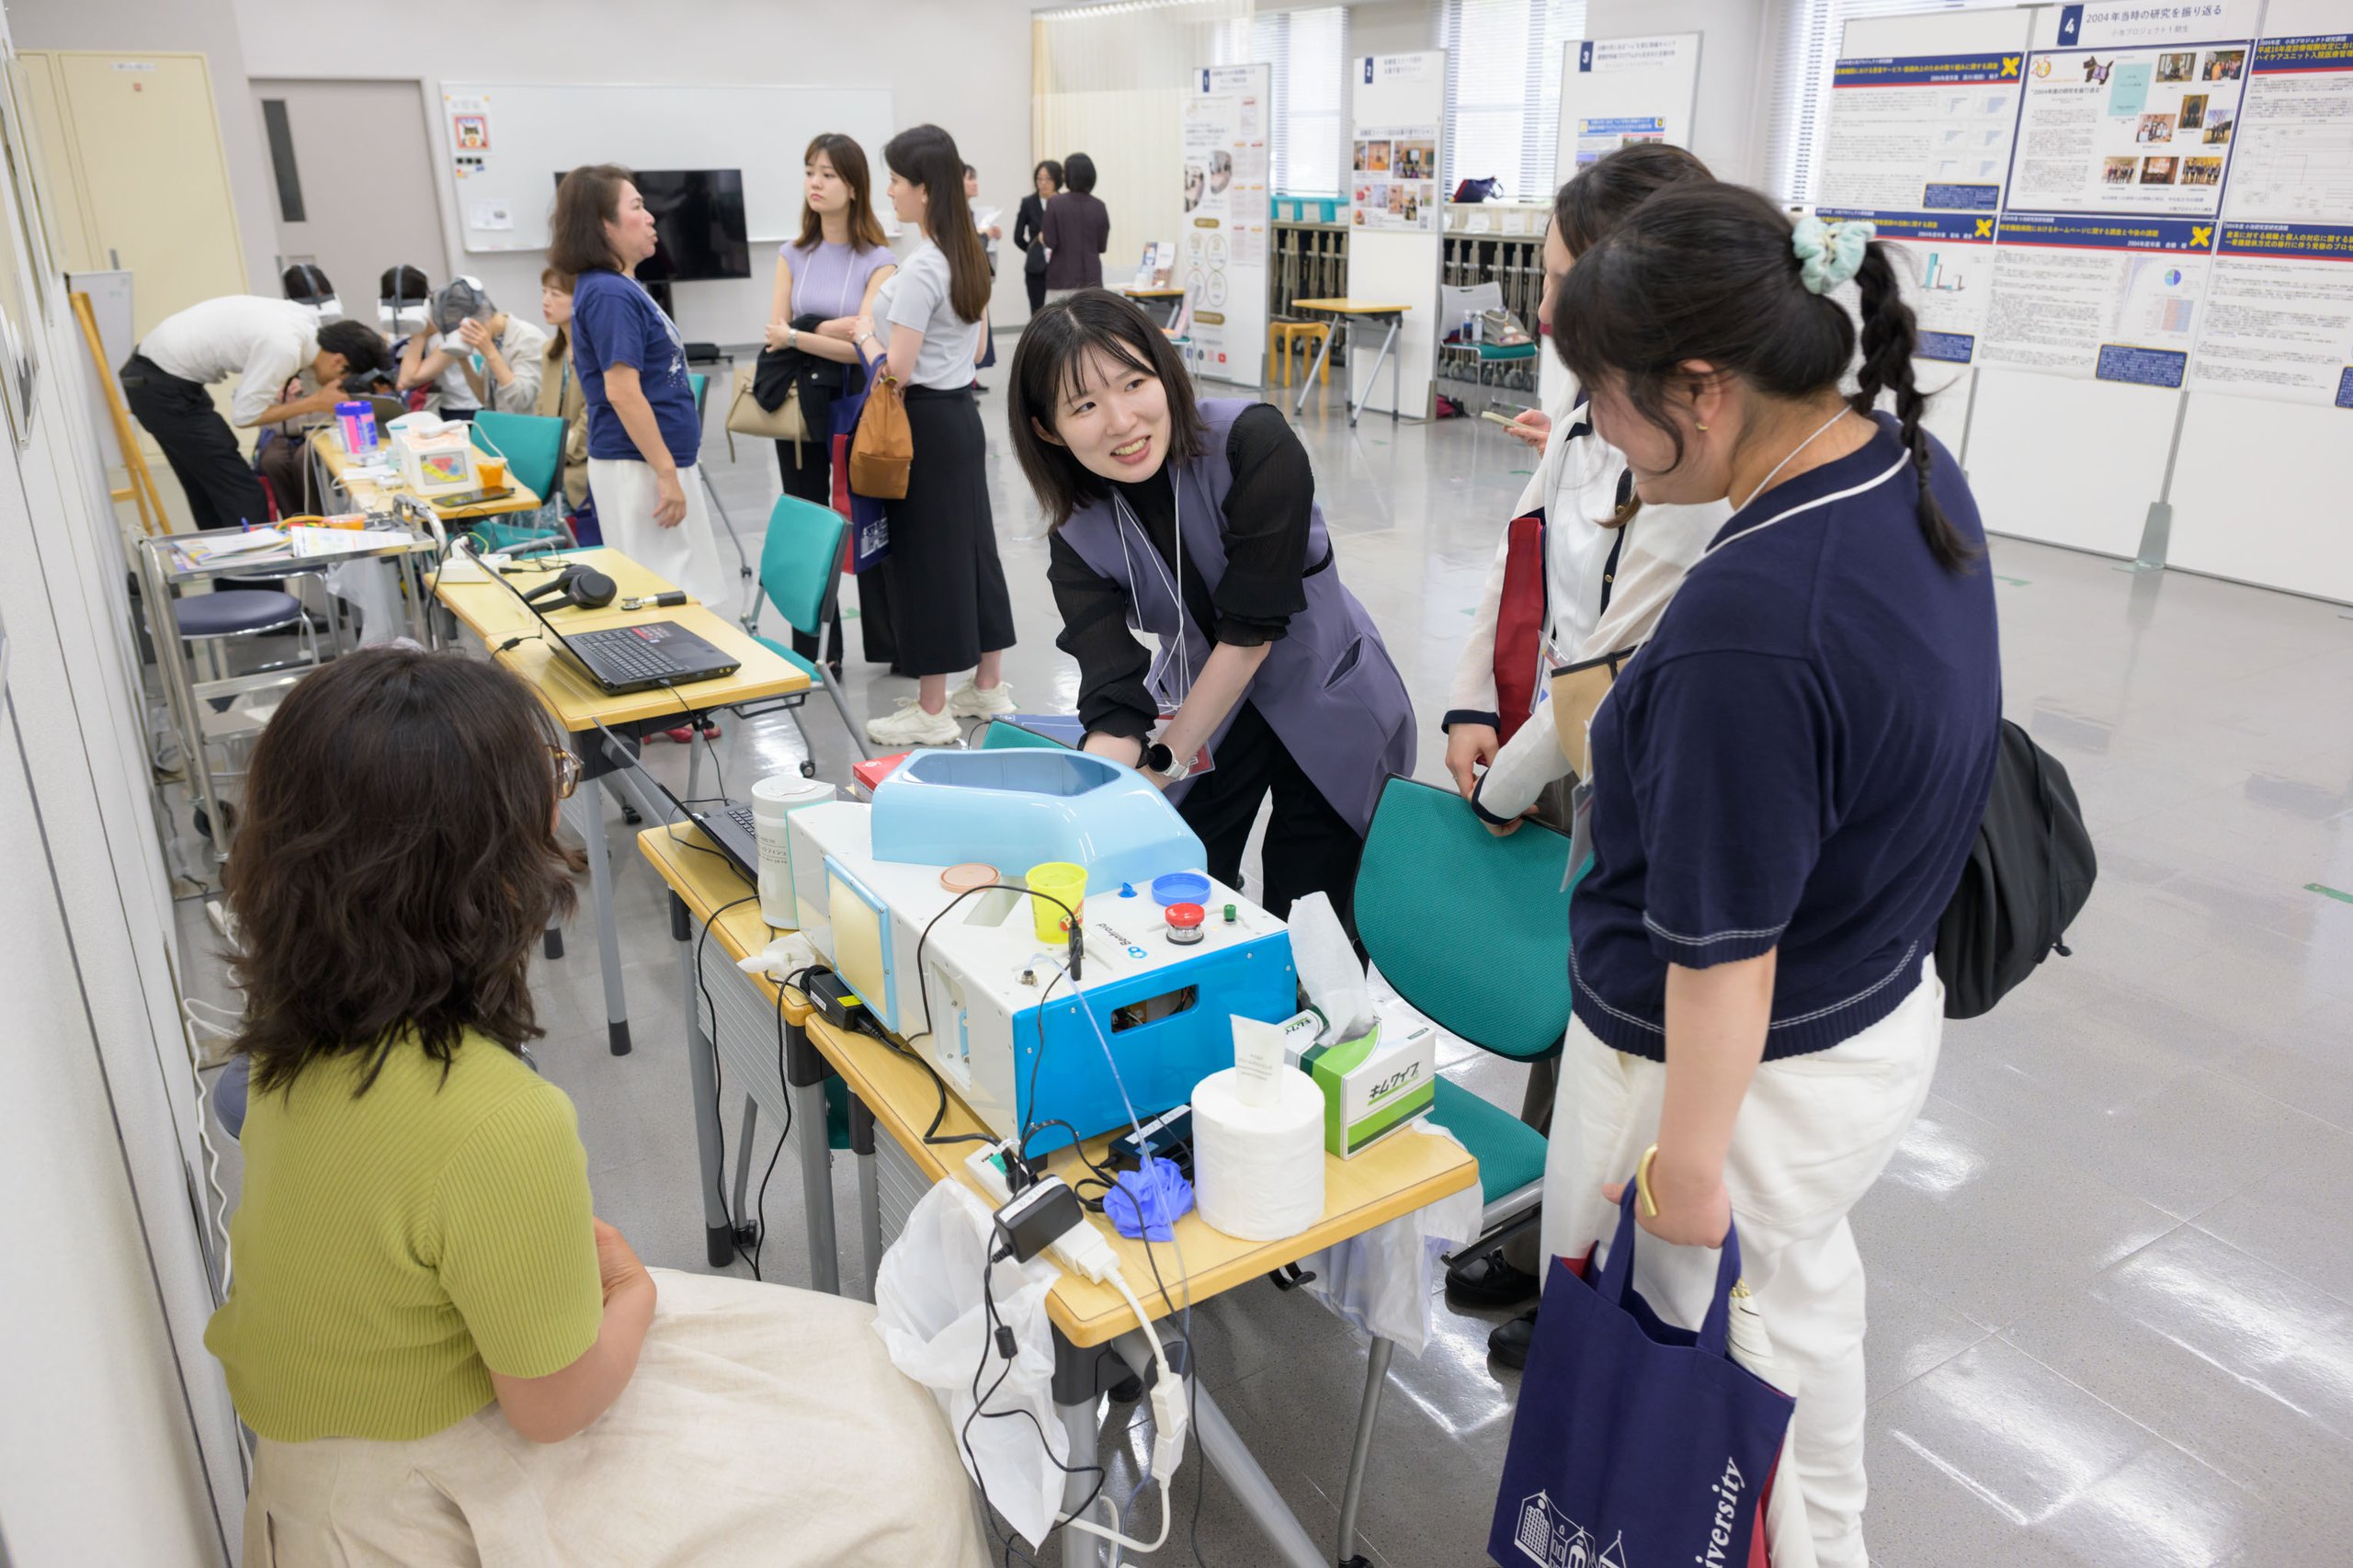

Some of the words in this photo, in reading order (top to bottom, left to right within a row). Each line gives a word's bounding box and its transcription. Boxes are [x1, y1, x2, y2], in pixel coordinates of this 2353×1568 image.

[2063, 17, 2075, 34] 4
[1582, 51, 1590, 63] 3
[1285, 1017, 1312, 1036] キムワイ
[1369, 1061, 1422, 1098] キムワイプ
[1695, 1456, 1745, 1568] iversity
